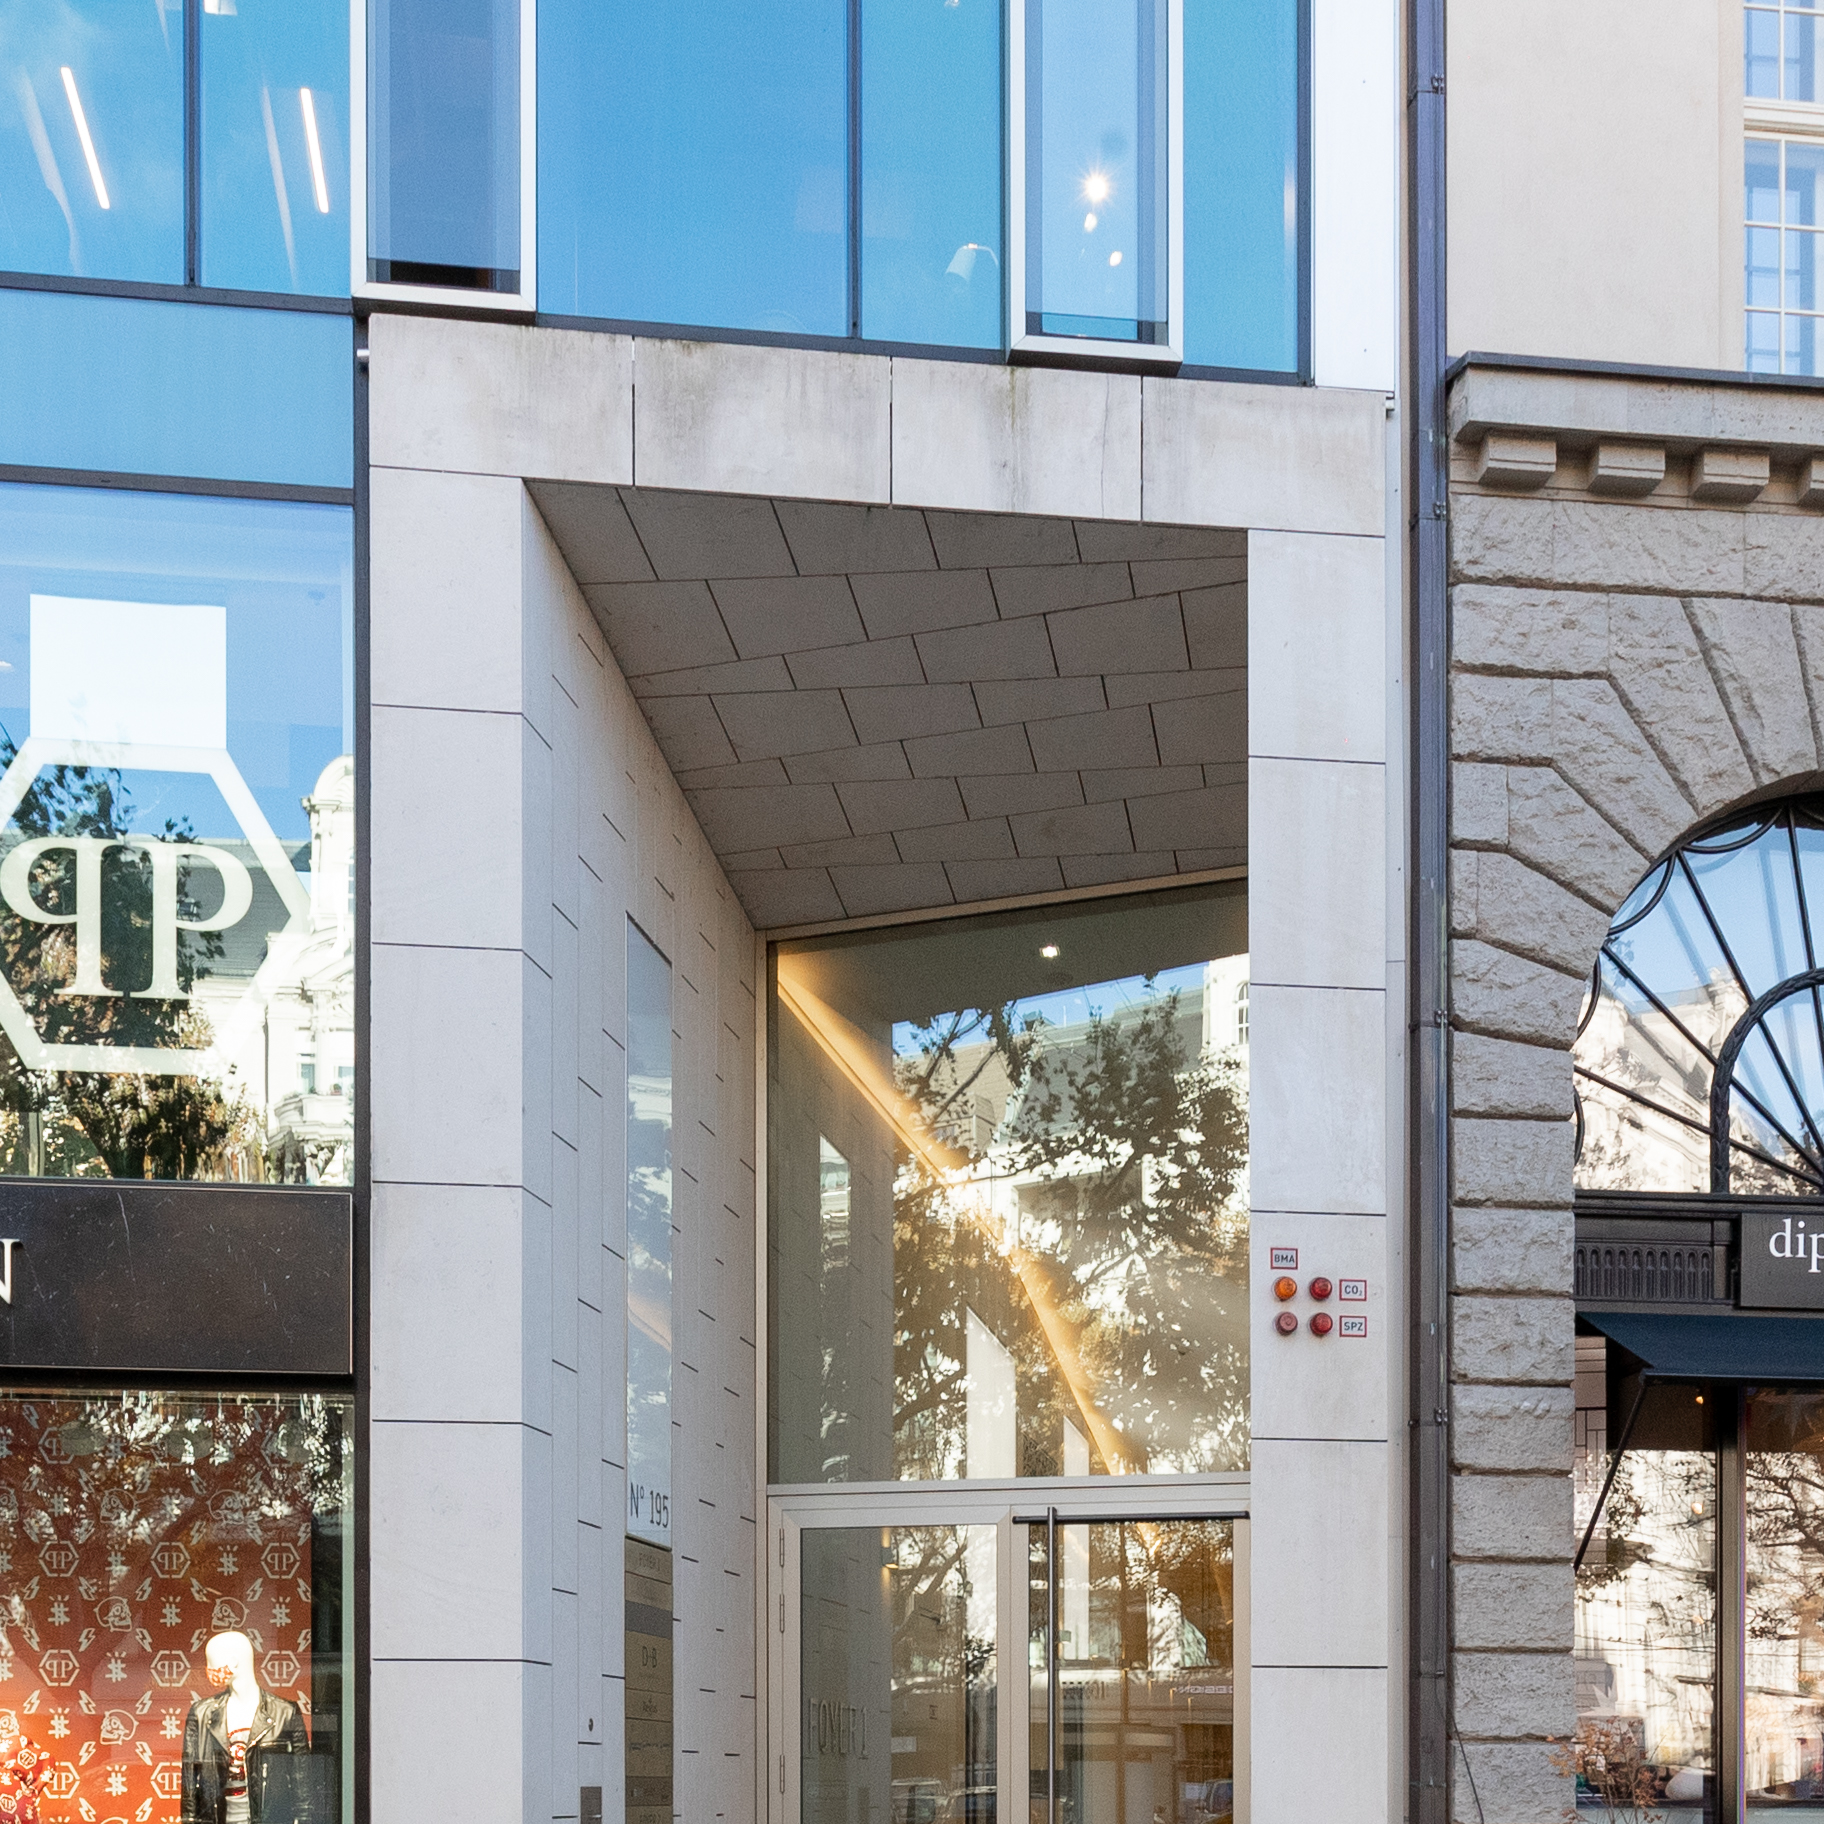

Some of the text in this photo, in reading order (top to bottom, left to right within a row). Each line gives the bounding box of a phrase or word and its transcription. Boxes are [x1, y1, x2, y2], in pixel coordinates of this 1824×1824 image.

[1274, 1253, 1295, 1263] BMA
[1344, 1322, 1363, 1332] SPZ
[649, 1490, 670, 1529] 195
